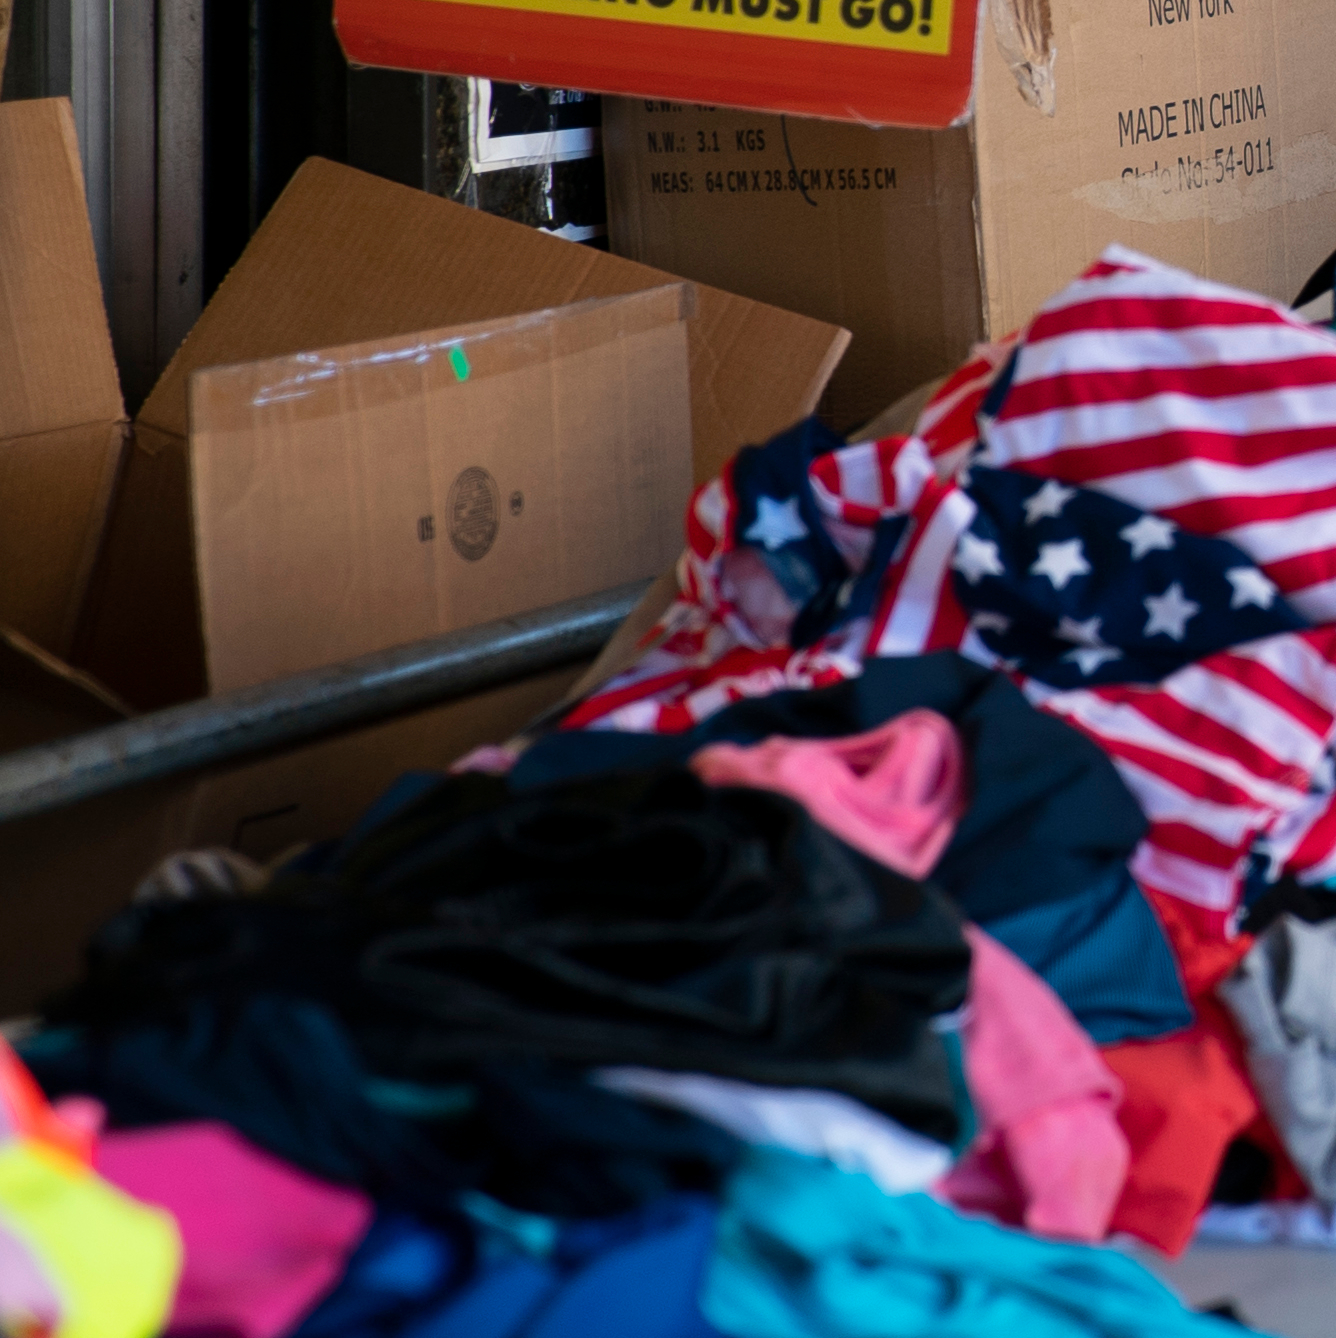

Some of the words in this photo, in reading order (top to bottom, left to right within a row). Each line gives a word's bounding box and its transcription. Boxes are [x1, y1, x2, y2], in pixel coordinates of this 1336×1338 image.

[1117, 101, 1178, 148] MADE
[1182, 96, 1205, 135] IN
[1209, 84, 1267, 129] CHINA
[697, 130, 720, 152] 3.1
[736, 129, 766, 151] KGS
[1214, 136, 1274, 184] 54-011
[651, 171, 693, 193] MEAS:
[705, 170, 724, 192] 64
[727, 170, 748, 192] CM
[752, 170, 762, 191] X
[765, 170, 797, 191] 28.8
[799, 169, 822, 191] CM
[825, 169, 835, 190] X
[838, 168, 870, 190] 56.5
[874, 168, 897, 190] CM
